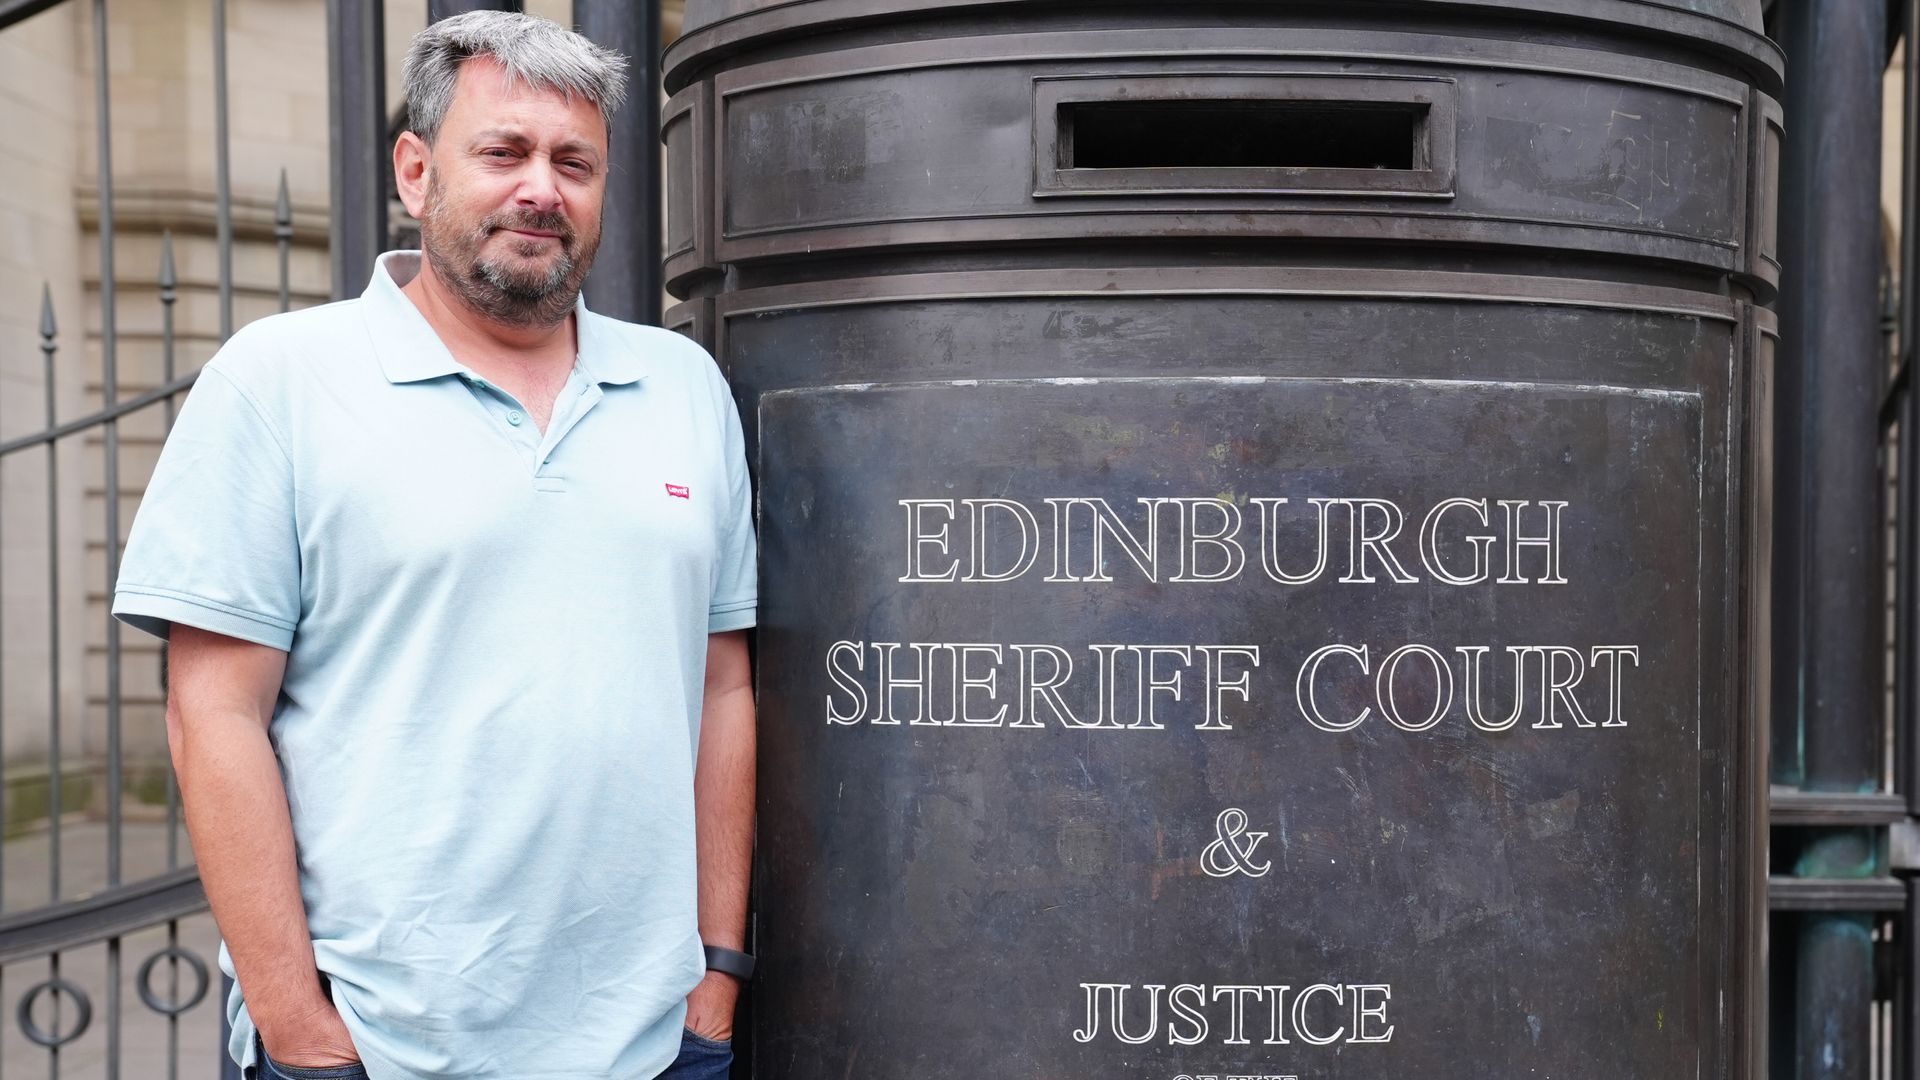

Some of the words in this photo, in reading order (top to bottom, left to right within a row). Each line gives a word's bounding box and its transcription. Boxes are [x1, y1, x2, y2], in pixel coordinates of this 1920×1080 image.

[898, 497, 1569, 586] EDINBURGH
[826, 640, 1260, 731] SHERIFF
[1295, 643, 1639, 733] COURT
[1199, 807, 1272, 878] &
[1072, 982, 1395, 1045] JUSTICE
